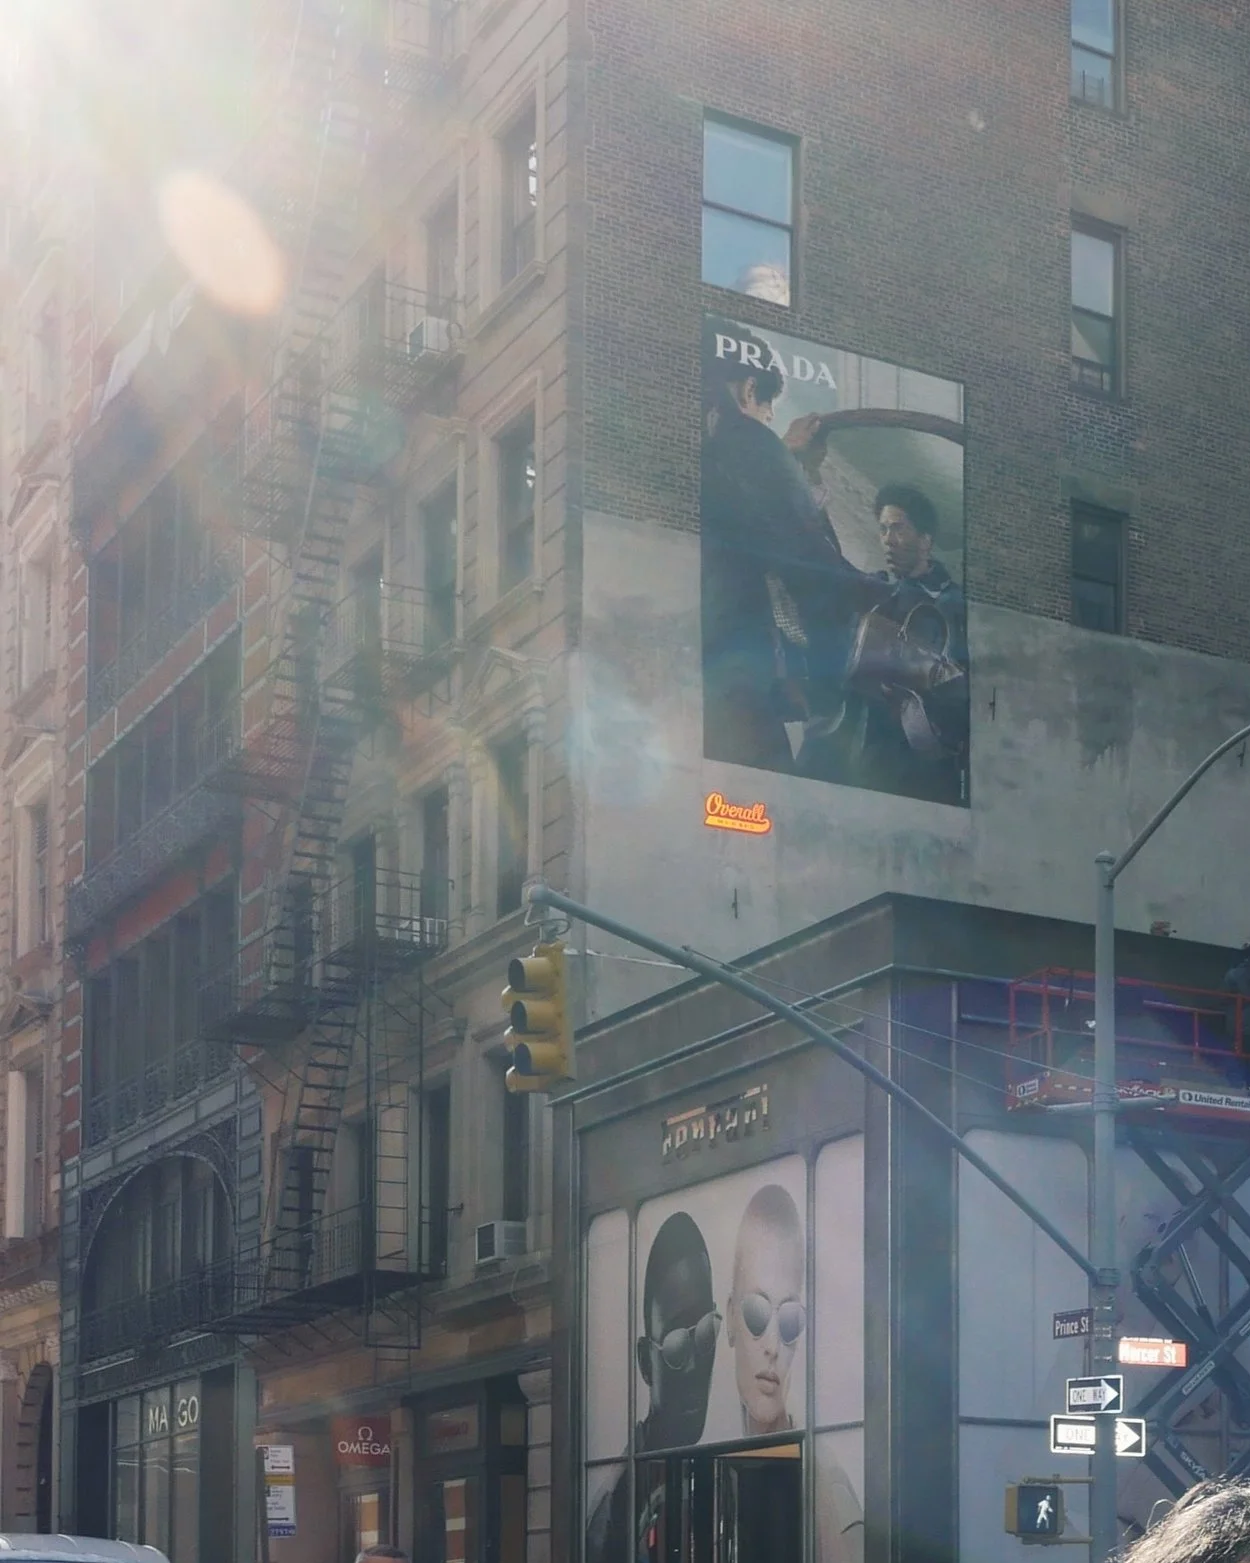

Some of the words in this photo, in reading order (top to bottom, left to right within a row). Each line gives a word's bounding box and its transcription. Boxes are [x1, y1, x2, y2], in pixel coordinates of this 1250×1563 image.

[715, 333, 838, 390] PRADA
[706, 793, 769, 822] Overall
[1194, 1094, 1224, 1106] United
[1055, 1319, 1079, 1337] Prince
[1080, 1316, 1089, 1333] St
[1163, 1344, 1177, 1363] St
[1072, 1389, 1087, 1403] ONE
[1092, 1388, 1106, 1402] WAY
[149, 1396, 199, 1435] MAGO
[338, 1441, 391, 1455] OMEGA
